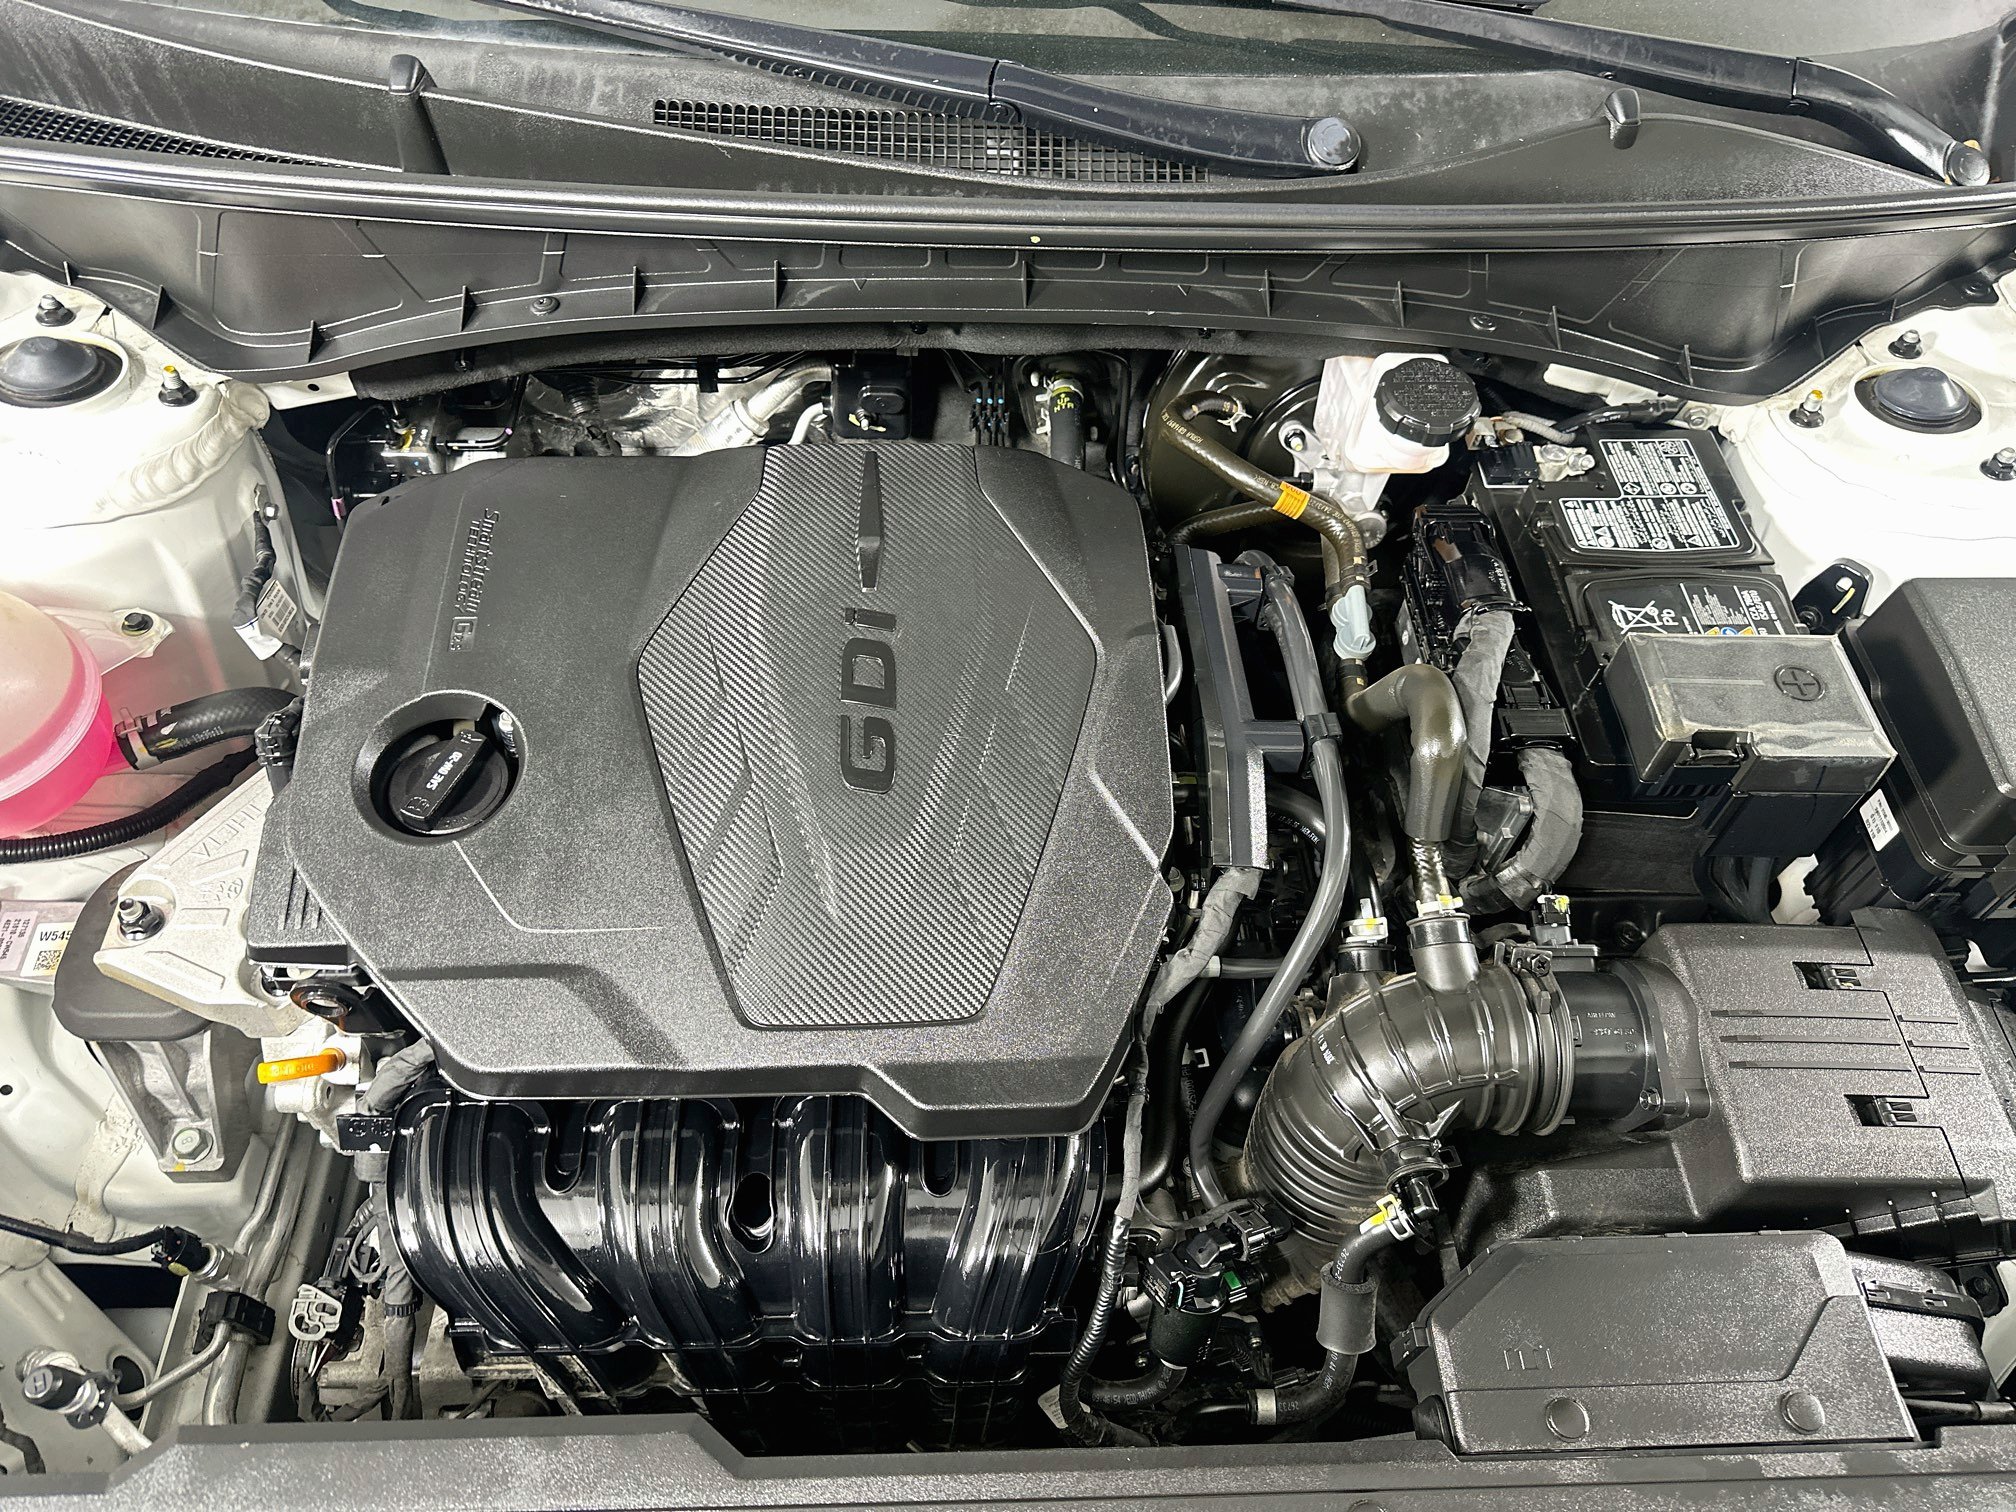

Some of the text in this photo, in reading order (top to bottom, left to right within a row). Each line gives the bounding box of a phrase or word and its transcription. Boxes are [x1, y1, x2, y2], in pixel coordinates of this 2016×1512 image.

[1053, 402, 1074, 413] HTR
[1056, 396, 1070, 405] UP
[454, 519, 482, 613] TECHNOLOGY
[465, 508, 500, 613] Smartstream
[1660, 608, 1679, 625] Pb
[424, 749, 463, 791] SAE 0W-20
